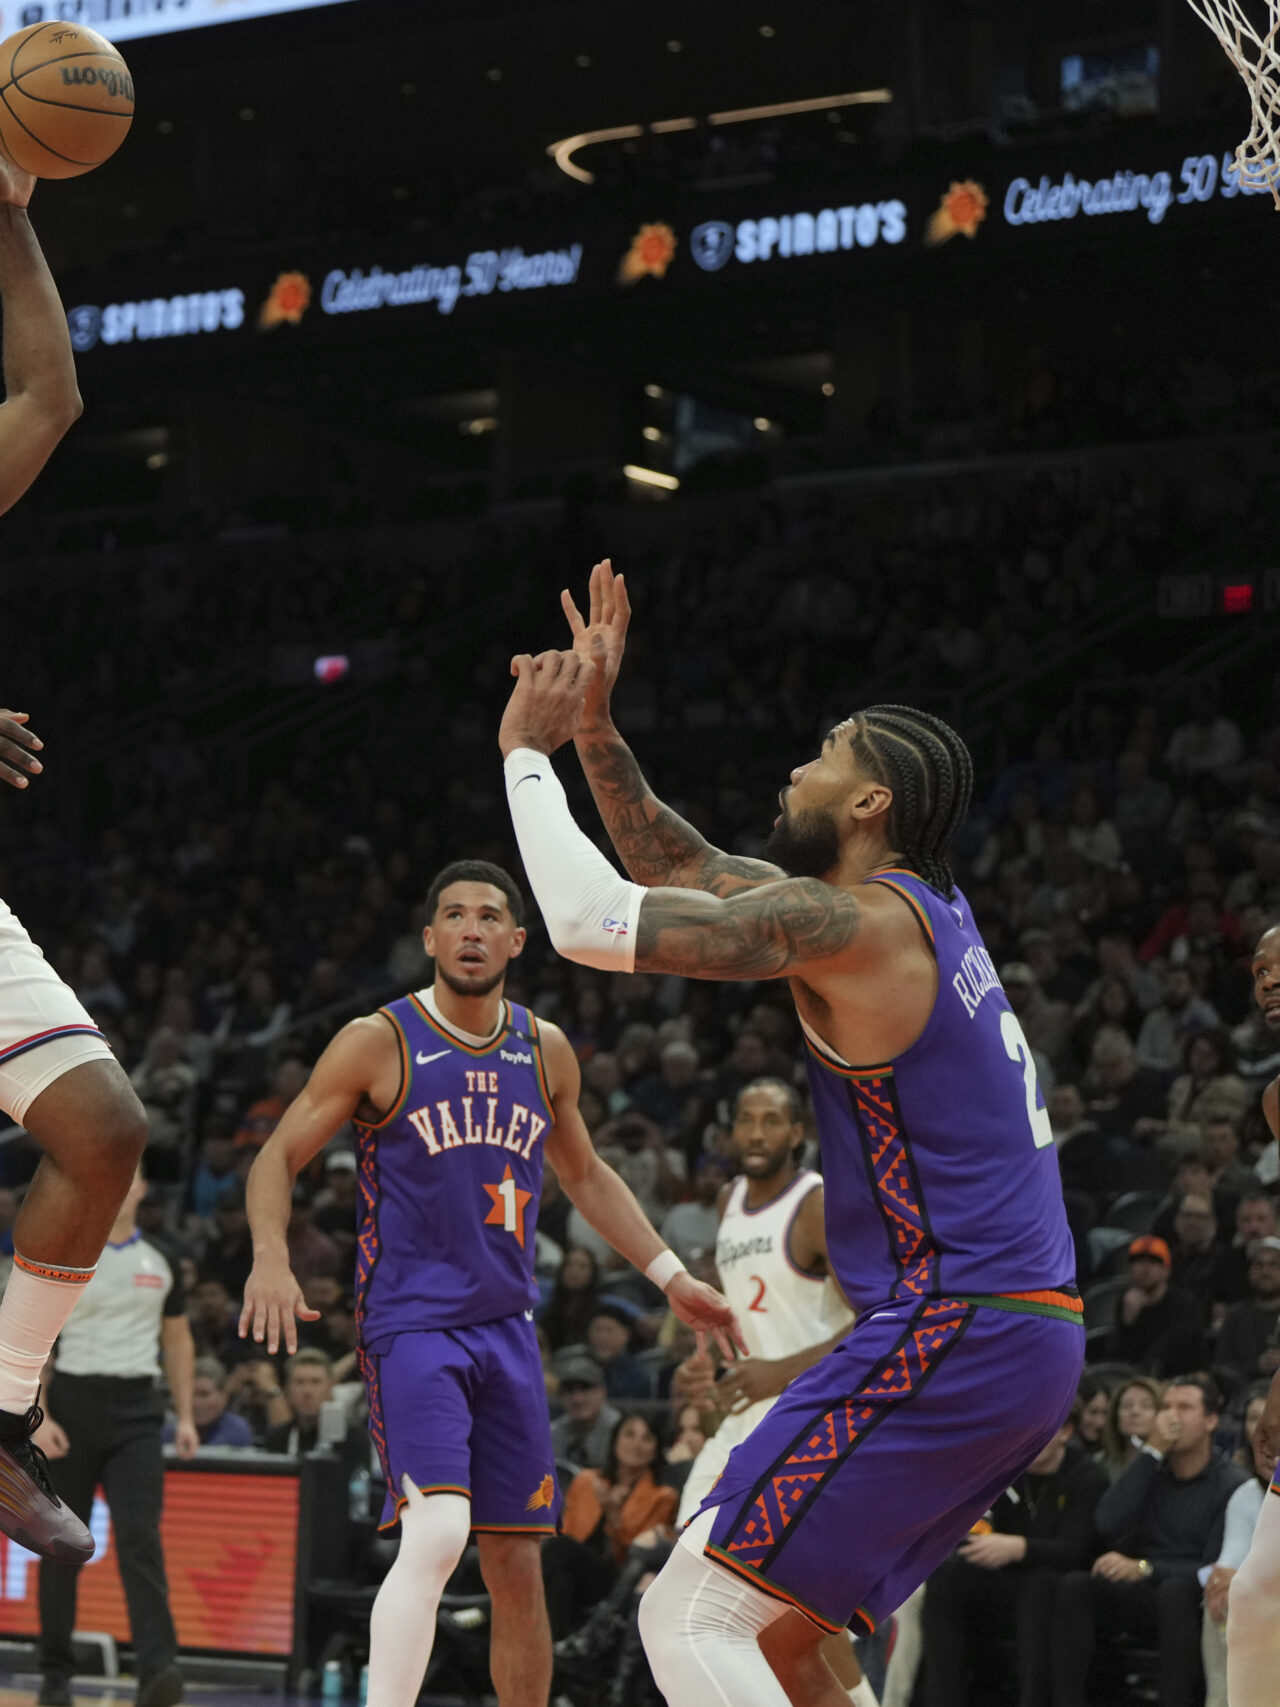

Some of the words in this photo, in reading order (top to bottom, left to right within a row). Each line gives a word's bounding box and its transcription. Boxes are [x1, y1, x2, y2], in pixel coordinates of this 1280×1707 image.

[1003, 172, 1173, 226] Celebrating
[1175, 154, 1219, 205] 50
[734, 198, 907, 264] SPINATO'S
[320, 265, 462, 316] Celebrating
[498, 242, 584, 293] Years!
[100, 287, 245, 345] SPINATO'S
[465, 1071, 499, 1093] THE
[500, 1049, 533, 1065] PayPal
[407, 1096, 546, 1160] VALLEY
[497, 1178, 518, 1232] 1
[748, 1274, 768, 1313] 2
